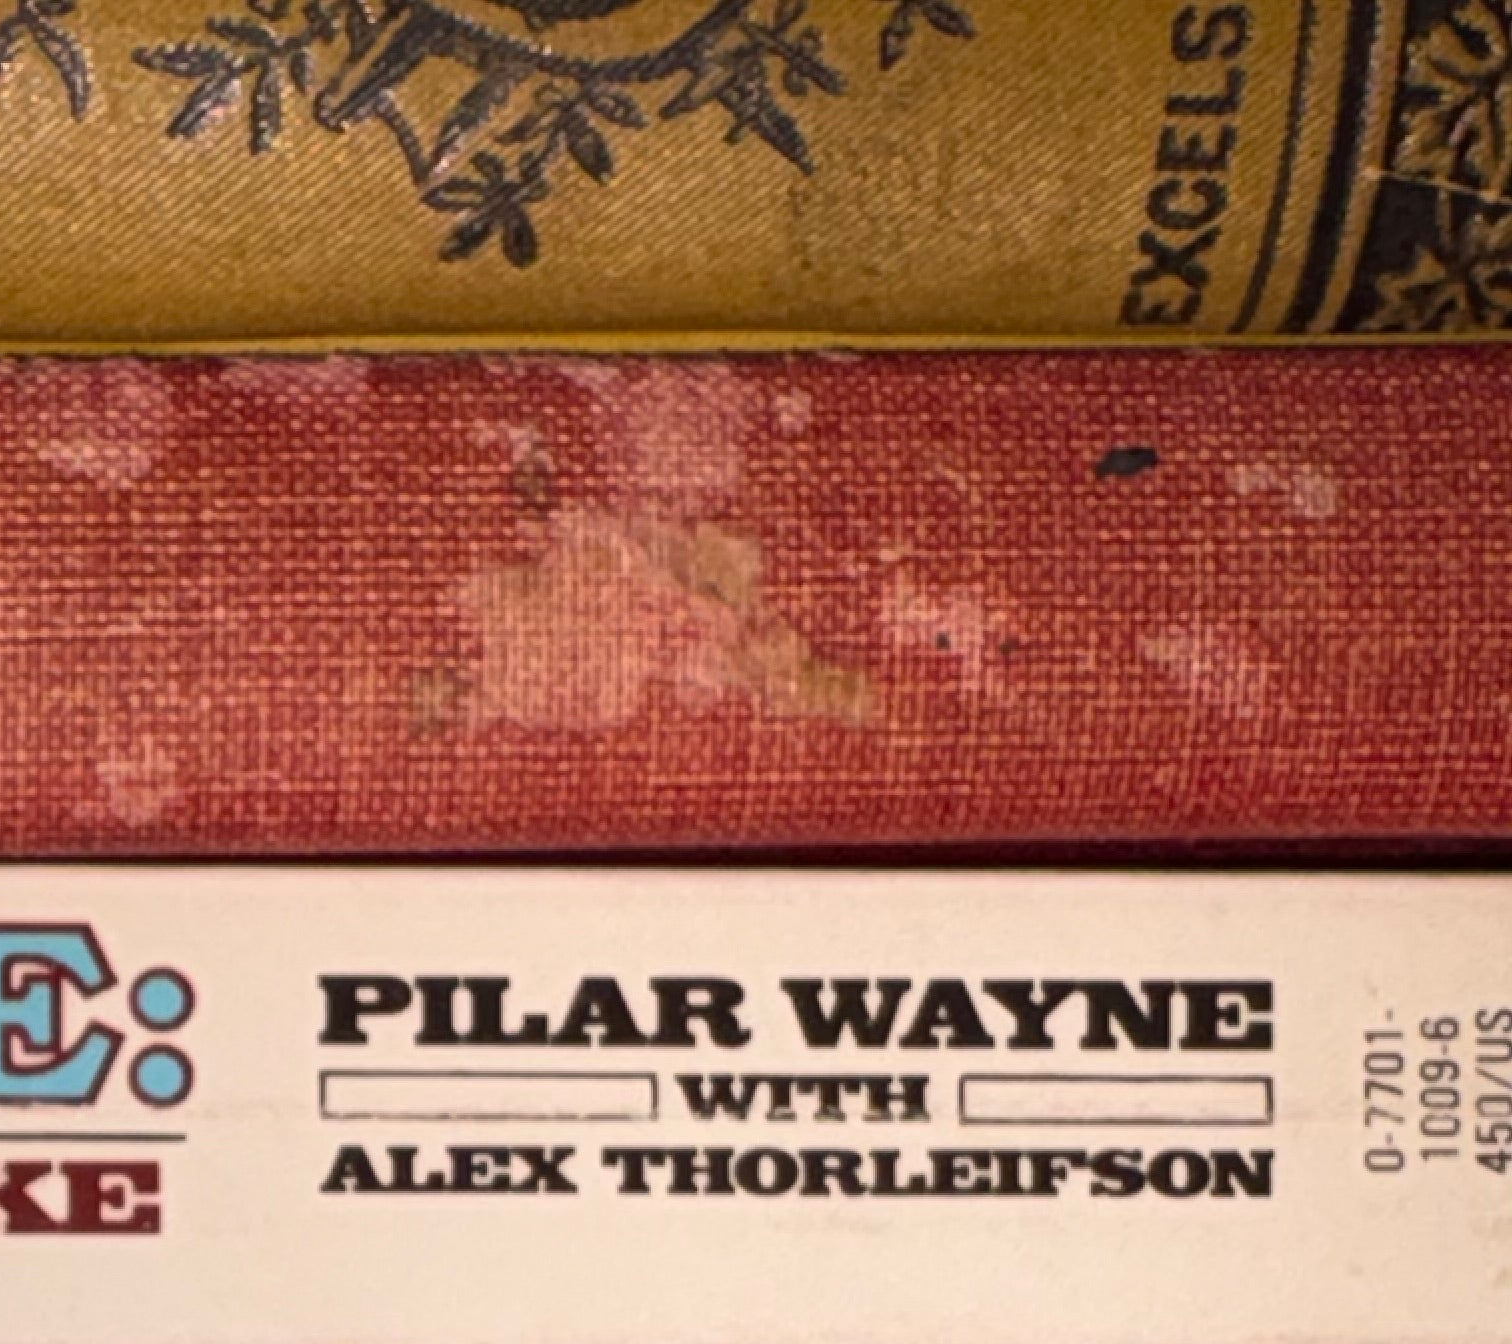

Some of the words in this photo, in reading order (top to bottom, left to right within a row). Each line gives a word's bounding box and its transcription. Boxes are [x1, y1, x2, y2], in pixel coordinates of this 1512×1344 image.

[317, 974, 752, 1048] PILAR
[779, 977, 1275, 1051] WAYNE
[674, 1073, 931, 1123] WITH
[1363, 1008, 1405, 1173] 0-7701-
[1418, 1015, 1461, 1162] 1009-6
[319, 1145, 577, 1195] ALEX
[601, 1147, 1275, 1198] THORLEIFSON
